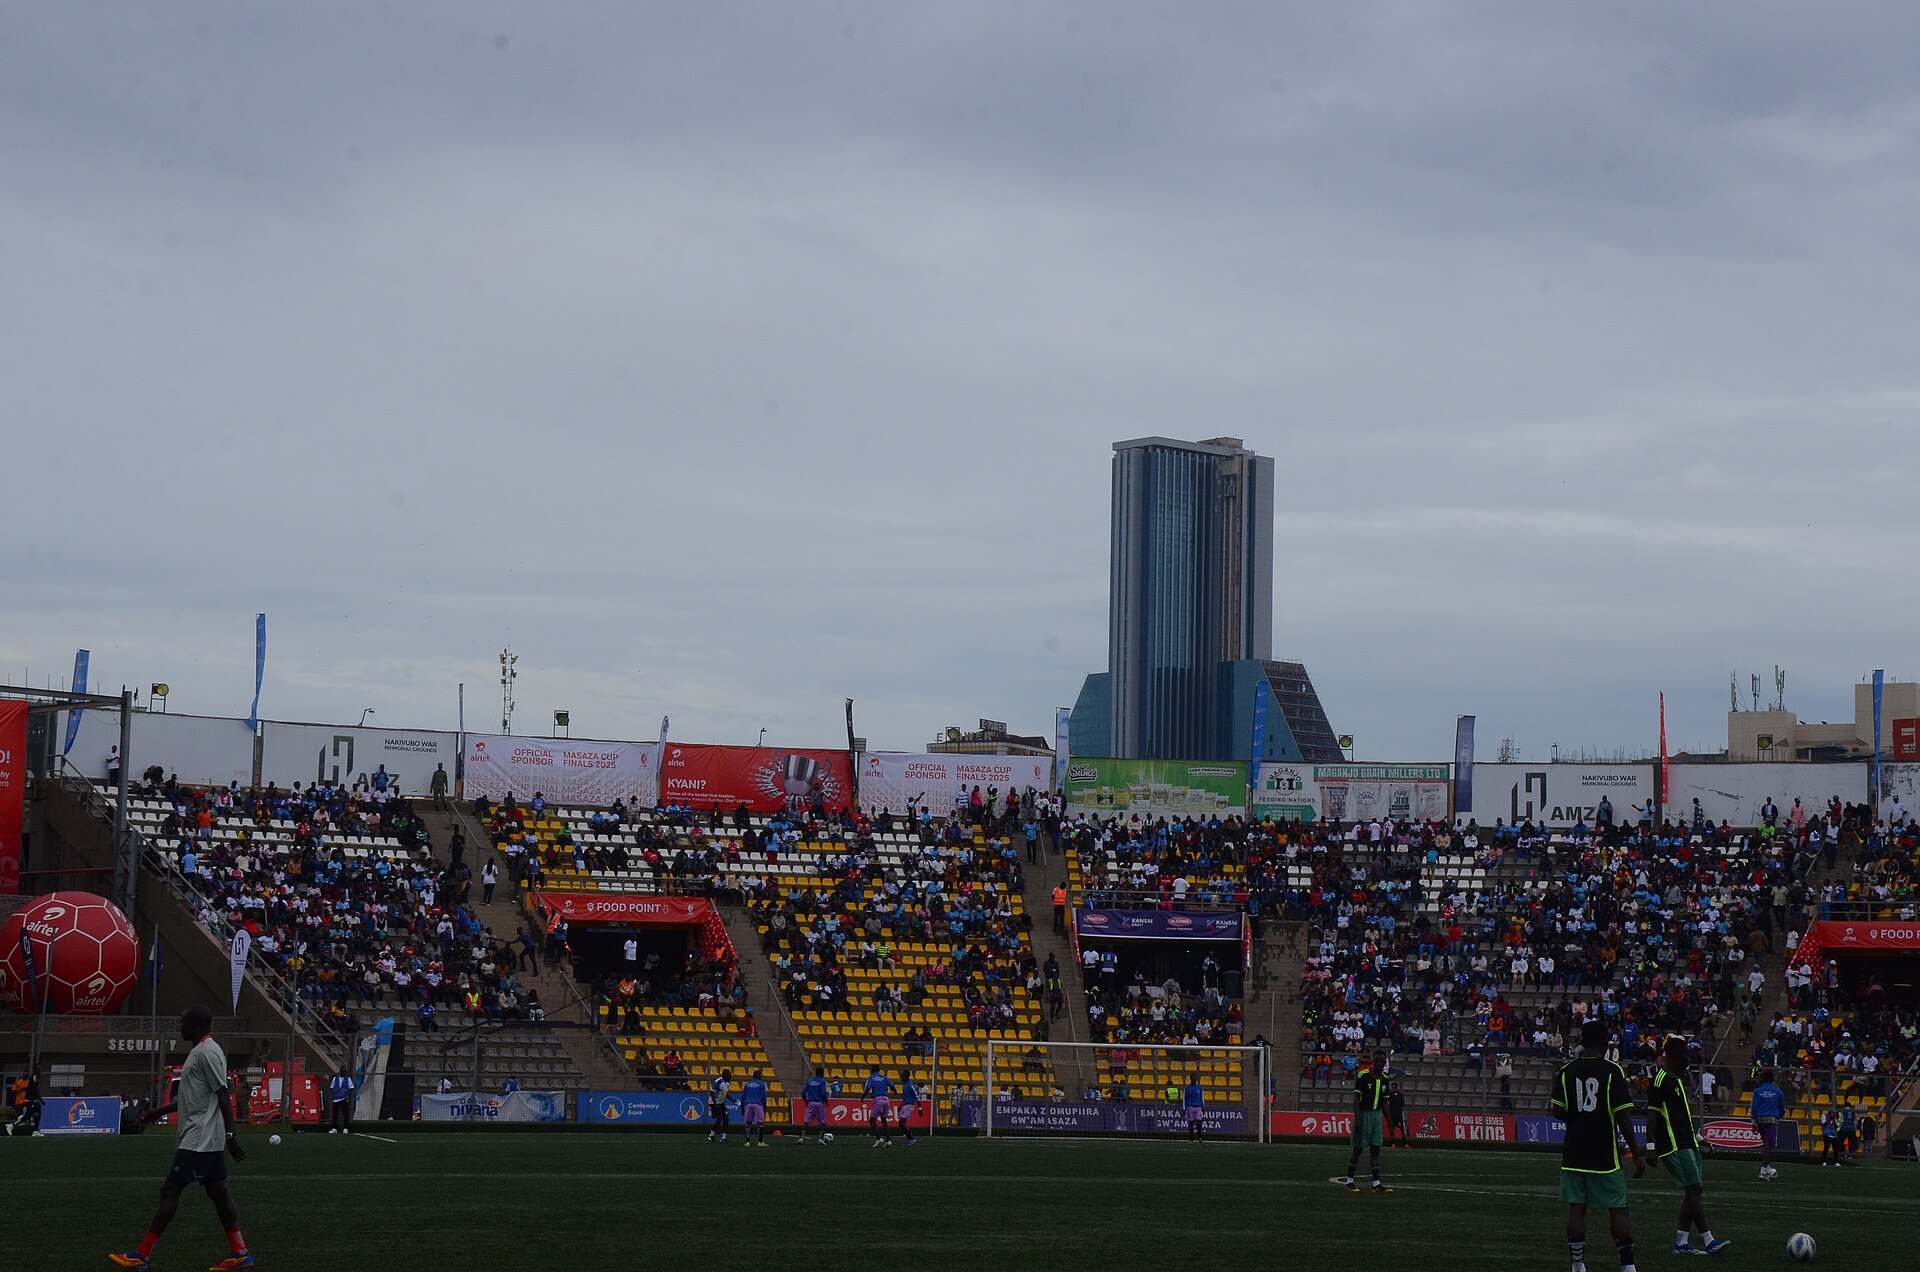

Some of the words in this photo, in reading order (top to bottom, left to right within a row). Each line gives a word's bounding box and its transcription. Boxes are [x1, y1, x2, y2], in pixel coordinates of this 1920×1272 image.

[384, 738, 420, 747] NAKIVUBO
[471, 754, 490, 762] airtel
[514, 748, 553, 758] OFFICIAL
[563, 751, 598, 761] MASAZA
[600, 753, 619, 761] CUP
[511, 756, 554, 766] SPONSOR
[563, 759, 594, 768] FINALS
[595, 761, 616, 769] 2025
[668, 759, 685, 767] airtel
[908, 763, 947, 772] OFFICIAL
[956, 765, 992, 773] MASAZA
[993, 766, 1012, 774] CUP
[864, 769, 884, 778] airtel
[904, 771, 947, 779] SPONSOR
[956, 773, 987, 781] FINALS
[988, 774, 1010, 782] 2025
[1269, 767, 1302, 781] MAGANJO
[1318, 768, 1358, 778] MAGANJO
[1360, 768, 1386, 778] GRAIN
[1388, 768, 1424, 779] MILLERS
[1426, 769, 1441, 779] LTD
[667, 778, 707, 790] KYANI?
[596, 902, 627, 913] FOOD
[629, 903, 661, 914] POINT
[1880, 929, 1914, 939] FOOD
[76, 996, 106, 1006] airtel
[108, 1039, 177, 1051] SECURIY
[1575, 1077, 1600, 1112] 18
[628, 1103, 660, 1111] Centenary
[996, 1106, 1037, 1115] EMPAKA
[1050, 1107, 1100, 1116] OMUPIIRA
[1475, 1116, 1504, 1126] DEERVES
[1455, 1125, 1466, 1140] A
[1469, 1125, 1505, 1141] KING
